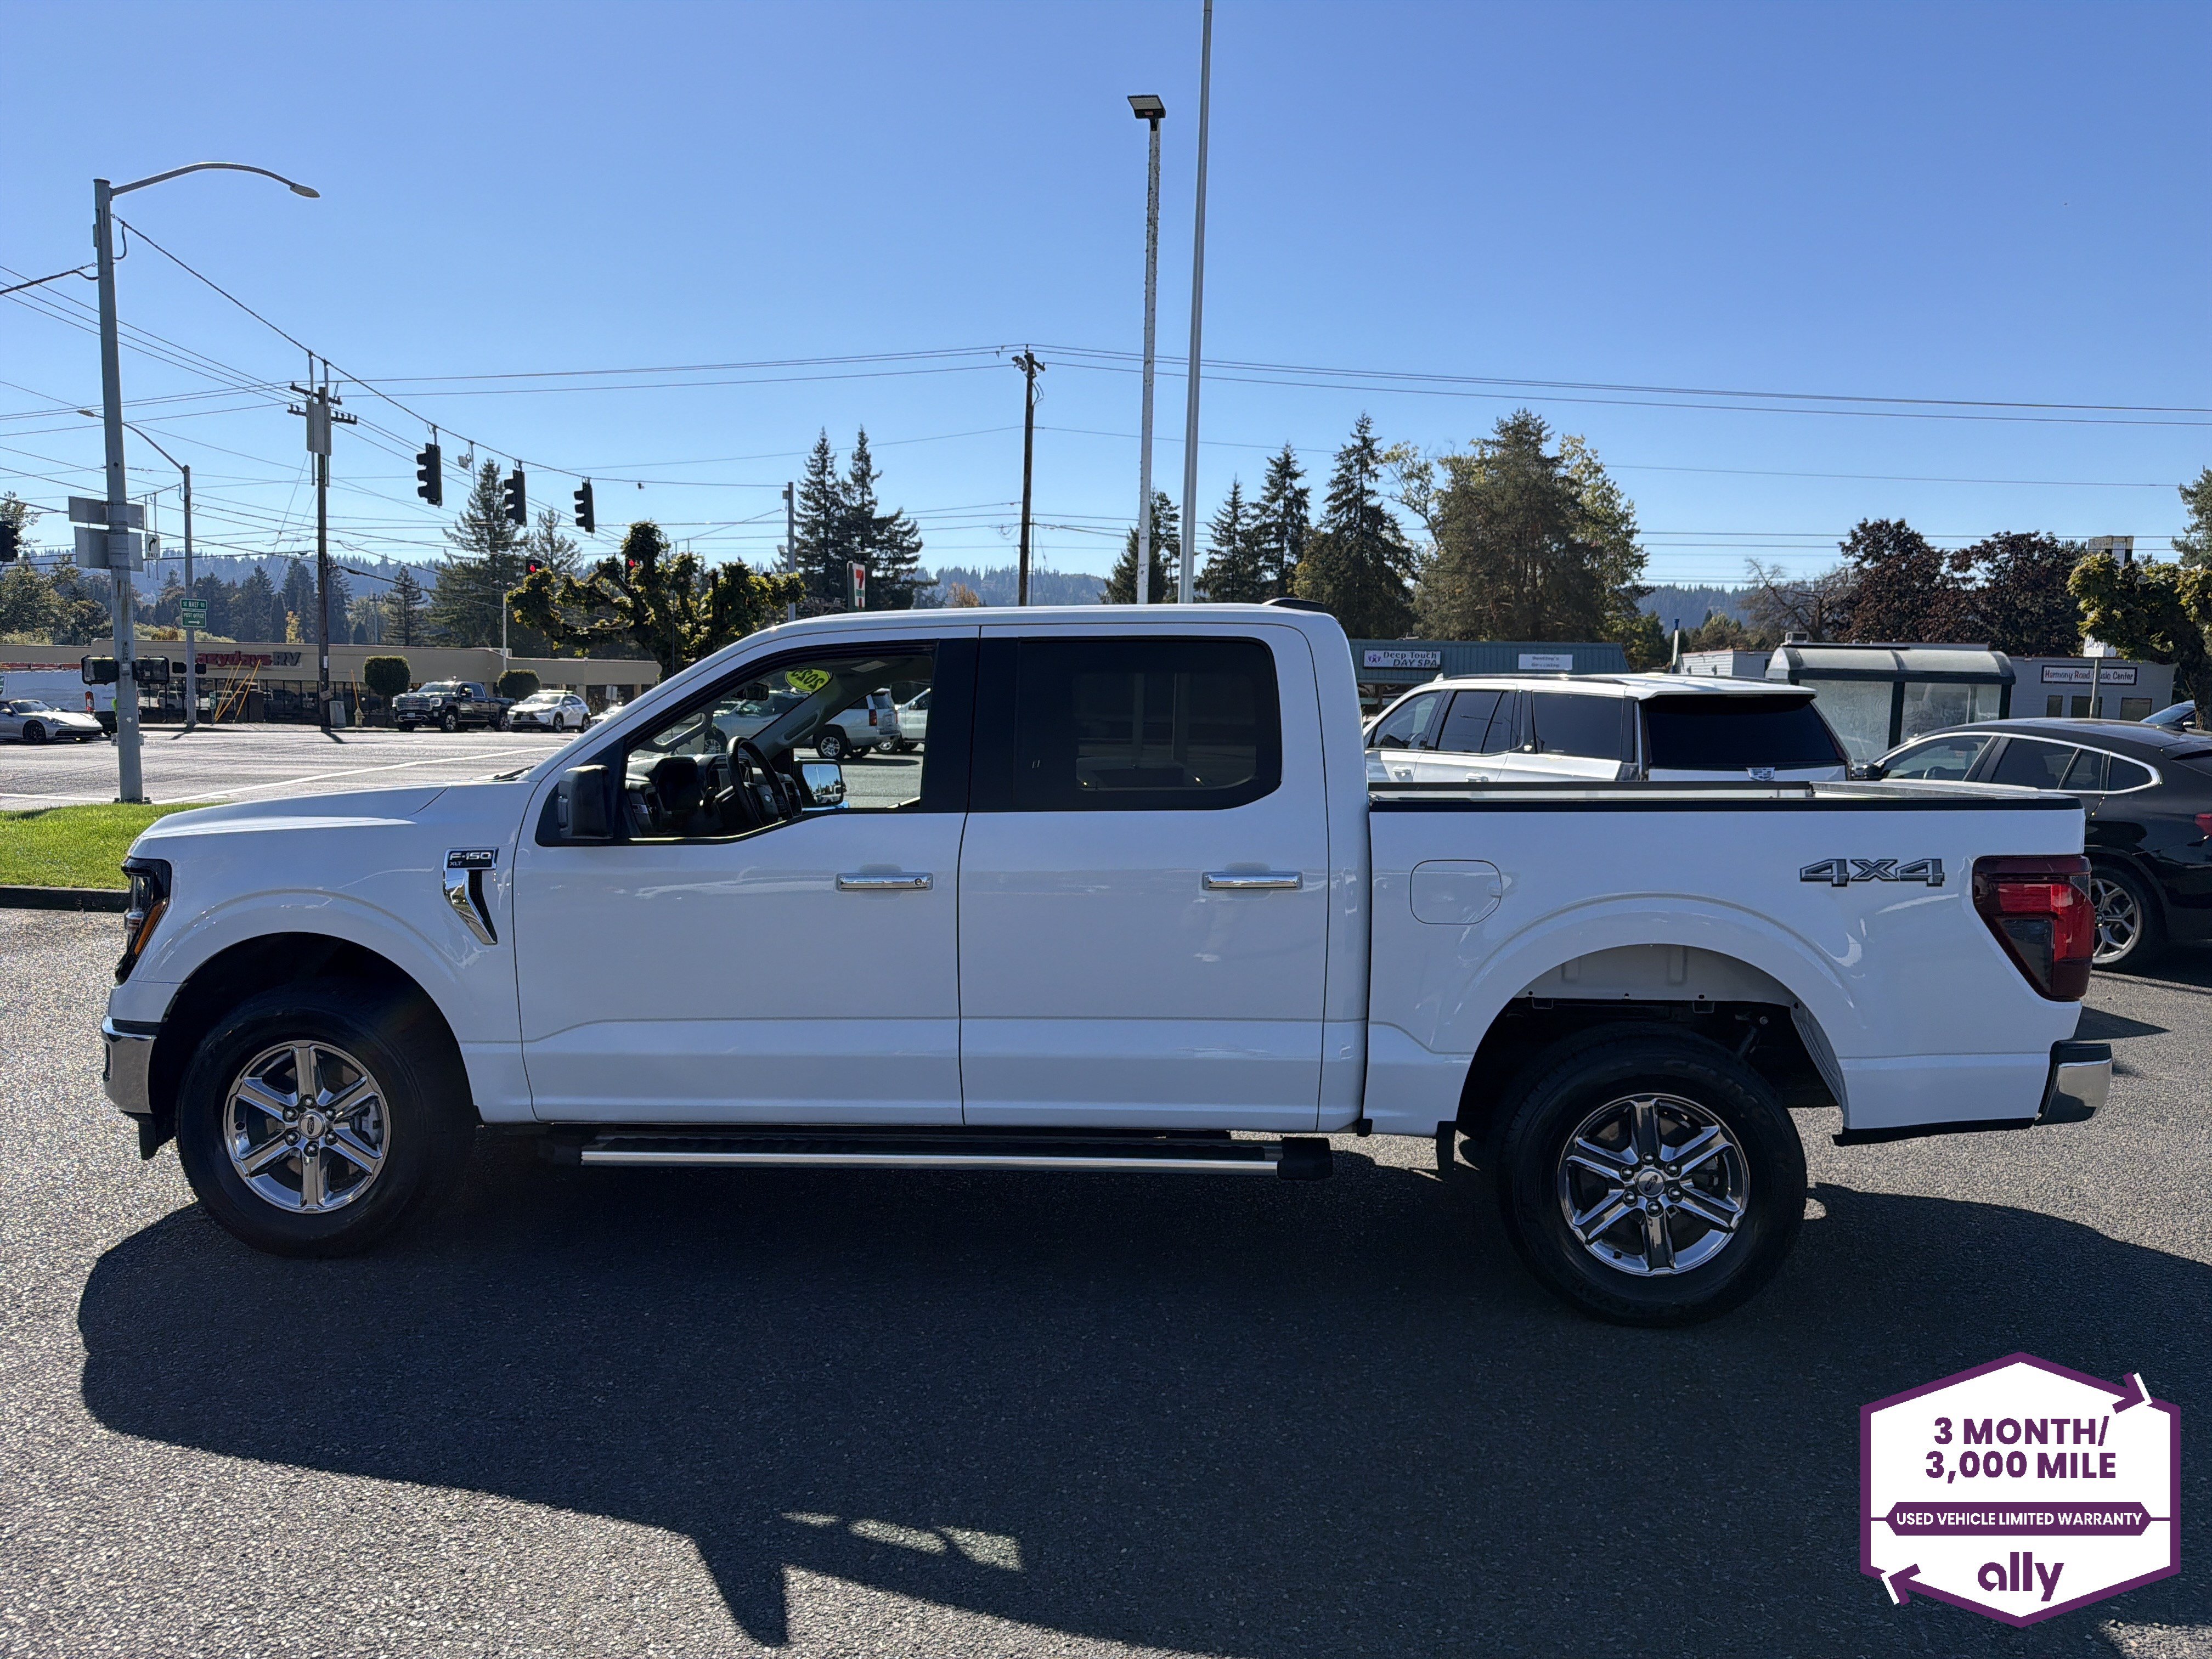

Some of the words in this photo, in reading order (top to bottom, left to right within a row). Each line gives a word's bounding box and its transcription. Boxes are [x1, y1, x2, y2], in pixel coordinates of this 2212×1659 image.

[856, 569, 864, 589] 7
[196, 651, 273, 668] azydays
[273, 652, 301, 666] RV
[2045, 670, 2073, 680] Harmony
[2074, 670, 2090, 679] Road
[2093, 671, 2111, 680] usic
[2113, 671, 2134, 680] Center
[449, 851, 492, 860] F-150
